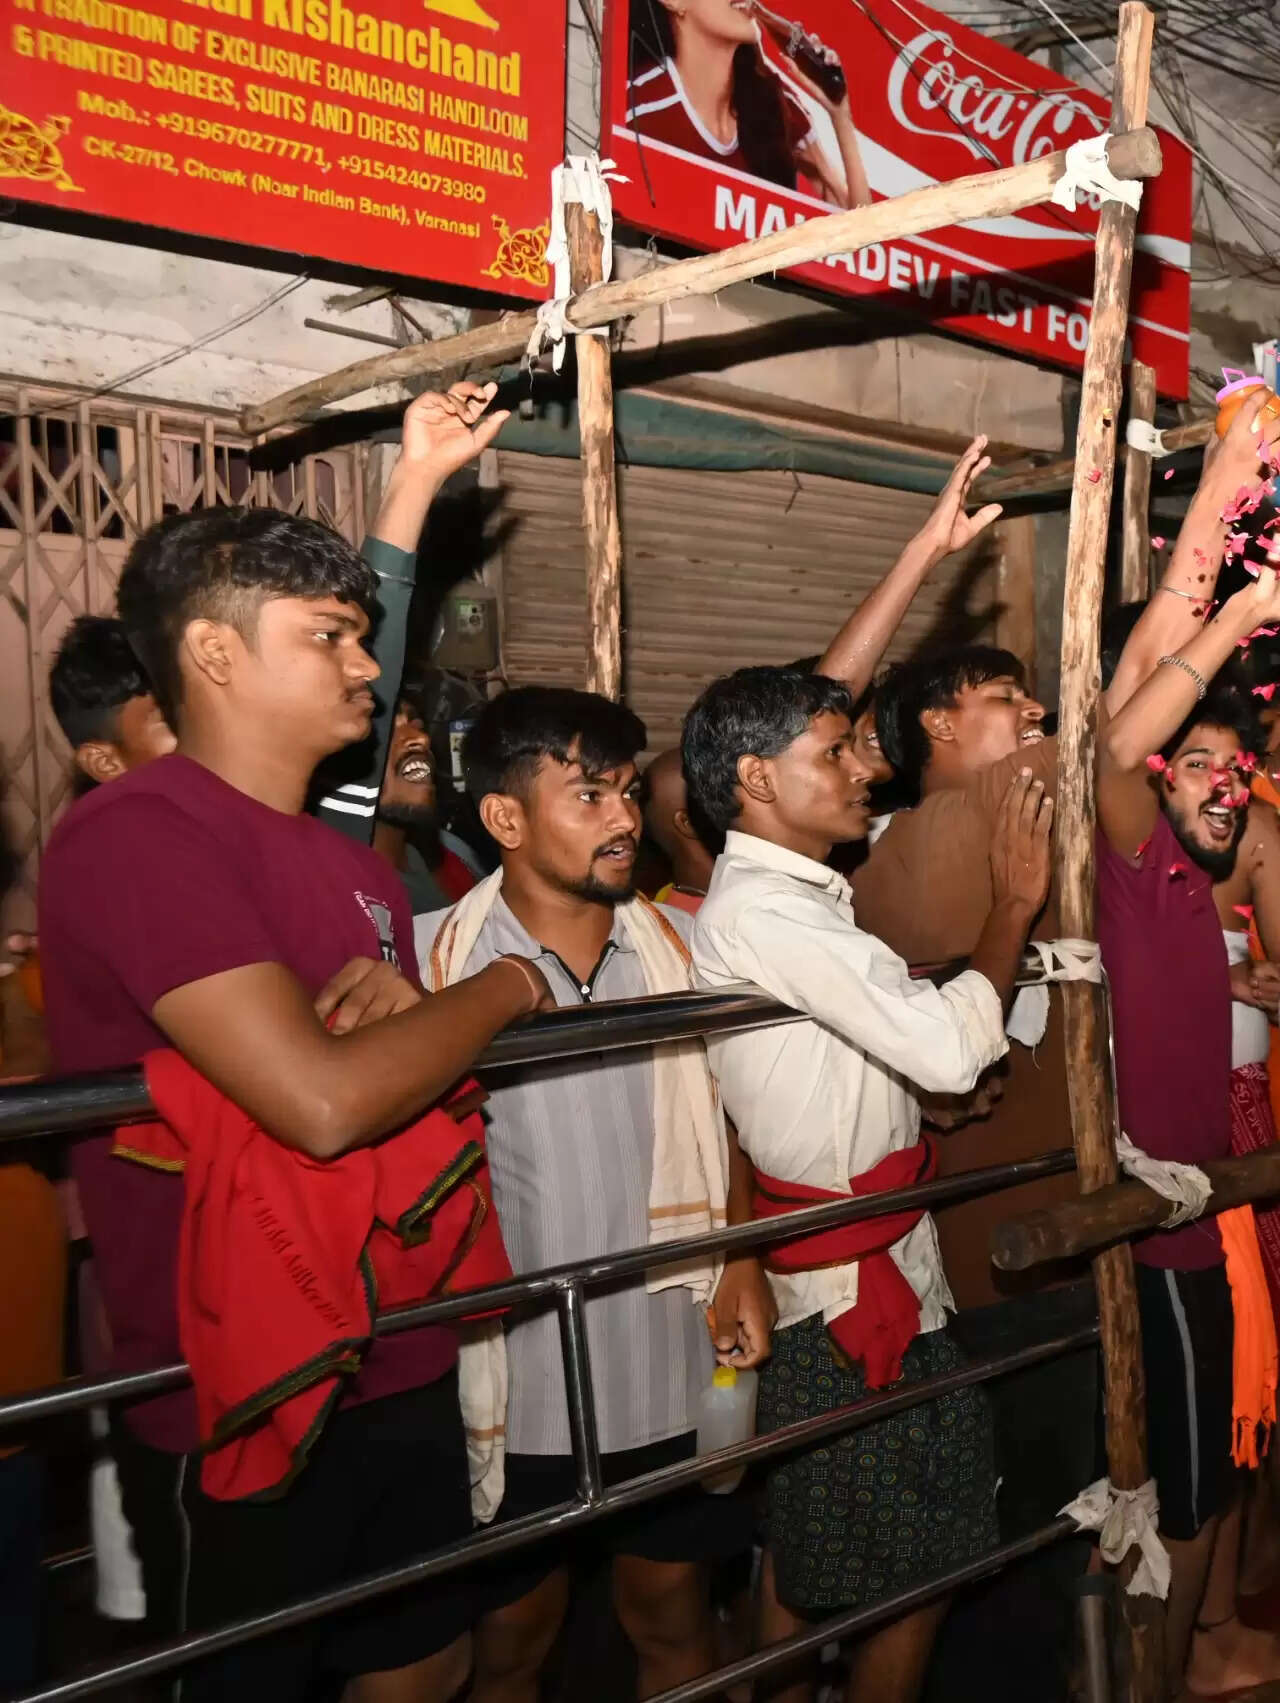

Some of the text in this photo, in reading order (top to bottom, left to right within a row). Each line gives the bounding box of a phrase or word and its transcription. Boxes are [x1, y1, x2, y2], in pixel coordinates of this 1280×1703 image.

[38, 29, 143, 84] PRINTED
[148, 58, 241, 111] SAREES,
[245, 83, 306, 124] SUITS
[311, 100, 353, 136] AND
[357, 111, 420, 152] DRESS
[424, 128, 529, 180] MATERIALS.
[77, 89, 151, 127] Mob.:
[172, 20, 202, 54] OF
[205, 29, 322, 87] EXCLUSIVE
[326, 62, 425, 114] BANARASI
[429, 90, 529, 143] HANDLOOM
[183, 157, 248, 188] Chowk
[302, 184, 355, 212] Indian
[359, 197, 411, 227] Bank),
[415, 209, 481, 238] Varanasi
[951, 269, 1039, 334] FAST
